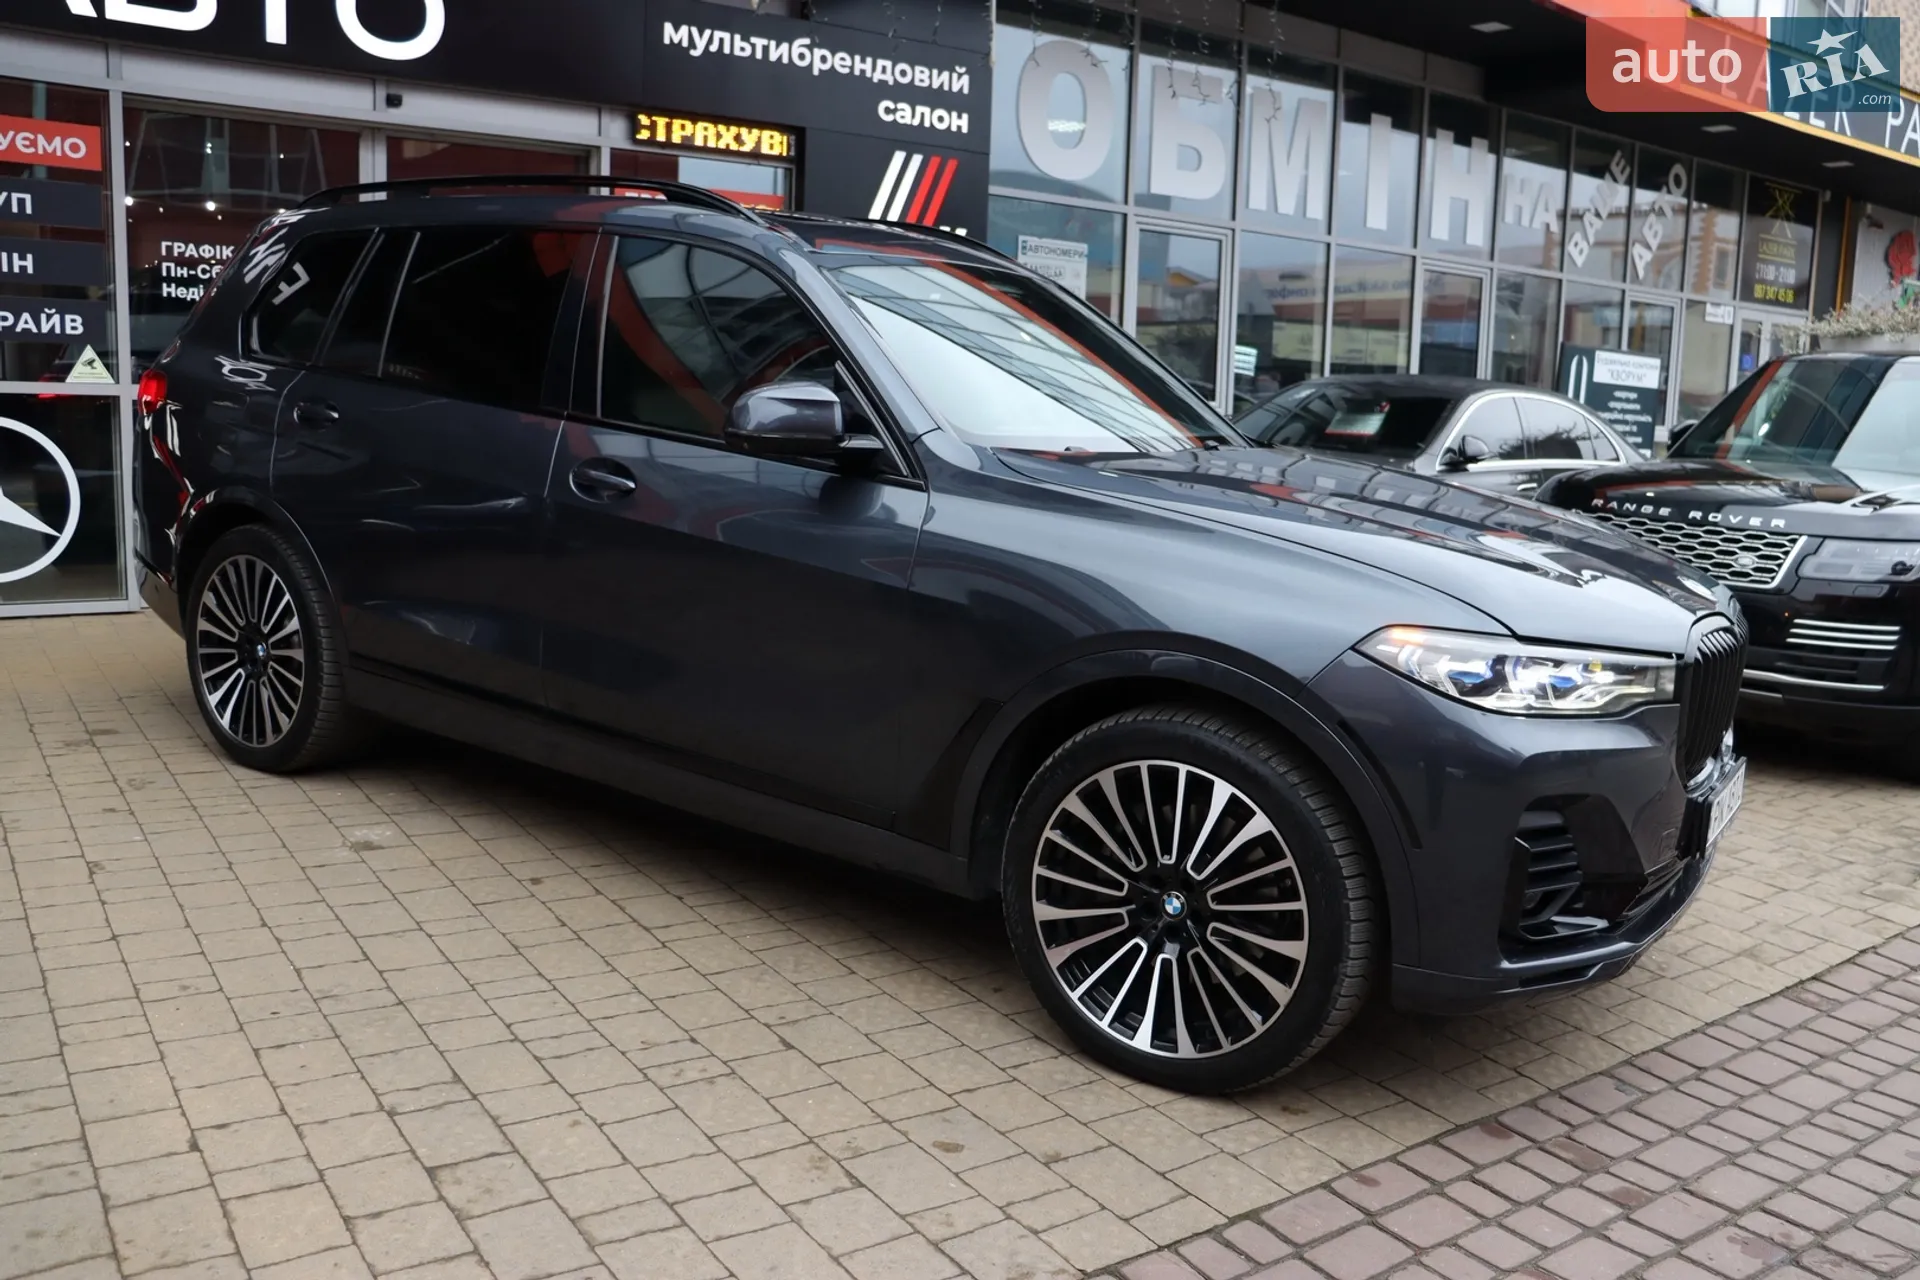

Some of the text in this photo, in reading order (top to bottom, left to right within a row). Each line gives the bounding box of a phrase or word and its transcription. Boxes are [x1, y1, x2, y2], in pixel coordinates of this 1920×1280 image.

[662, 21, 971, 96] мультибрендовий
[877, 99, 969, 134] салон
[1016, 39, 1688, 280] ОБМІН НА ВАШЕ АВТО
[160, 240, 235, 260] ГРАФІК
[1590, 498, 1788, 529] RANGE ROVER
